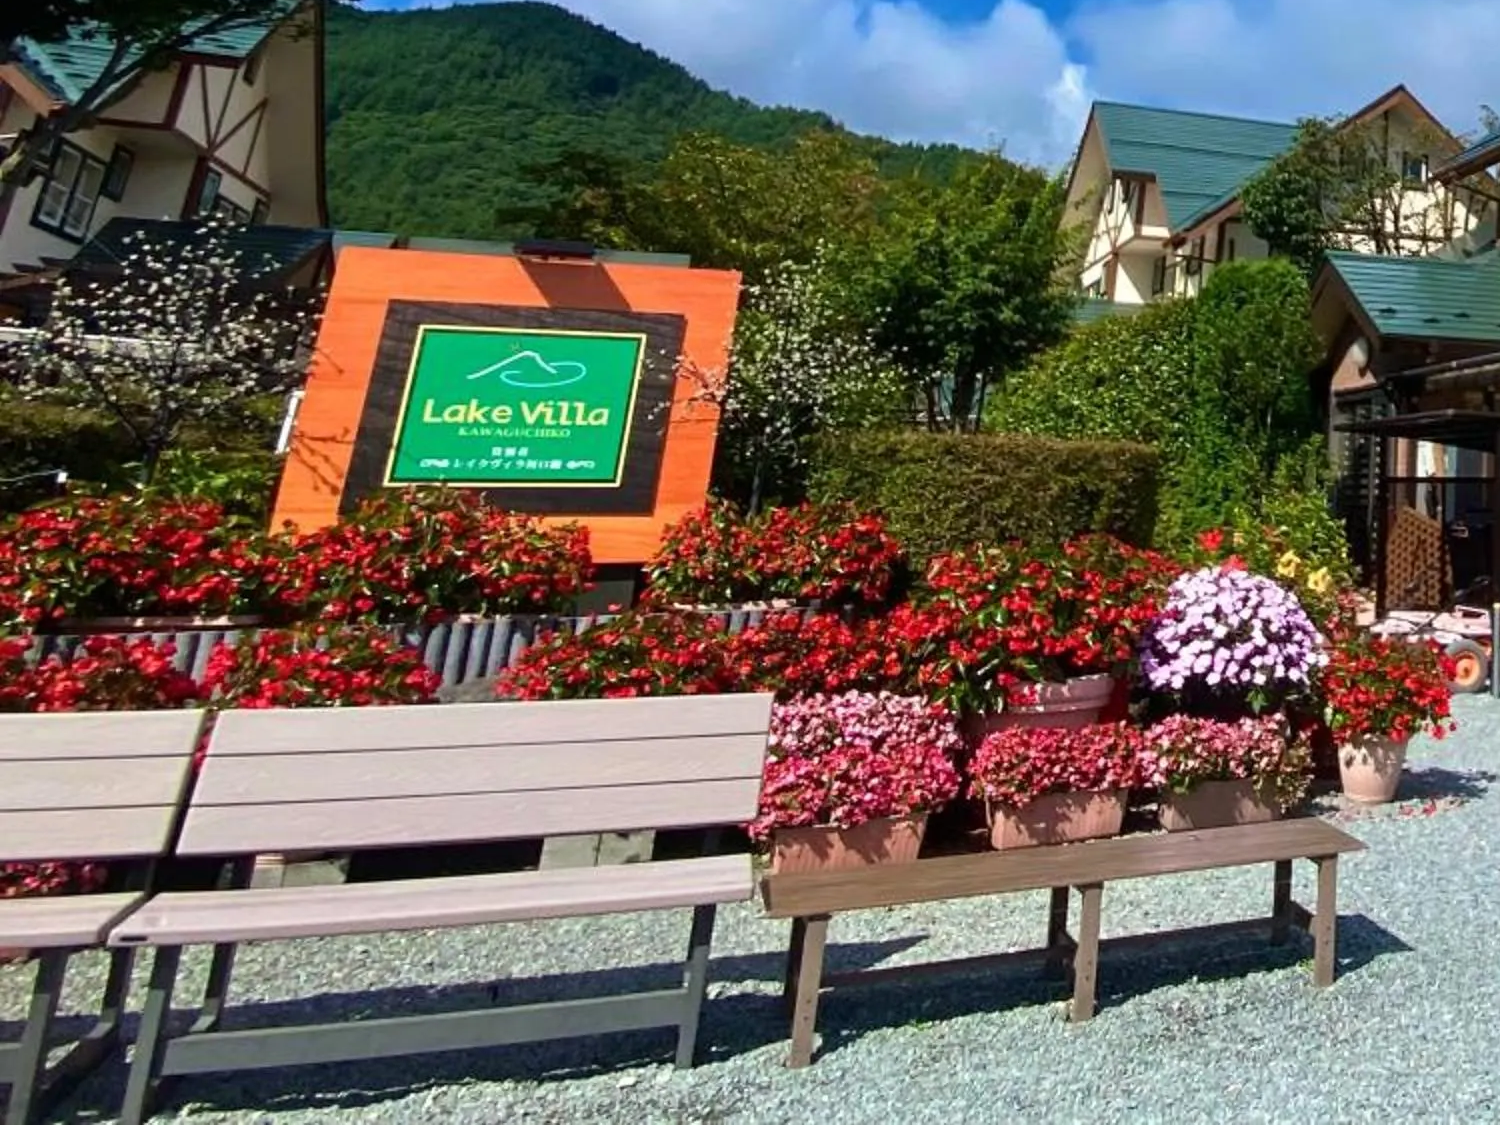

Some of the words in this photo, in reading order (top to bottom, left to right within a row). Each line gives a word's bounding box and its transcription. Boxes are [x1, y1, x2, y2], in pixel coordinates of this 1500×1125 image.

[423, 398, 513, 424] Lake
[519, 400, 610, 426] Villa
[458, 426, 571, 438] KAWAGUCHIKO
